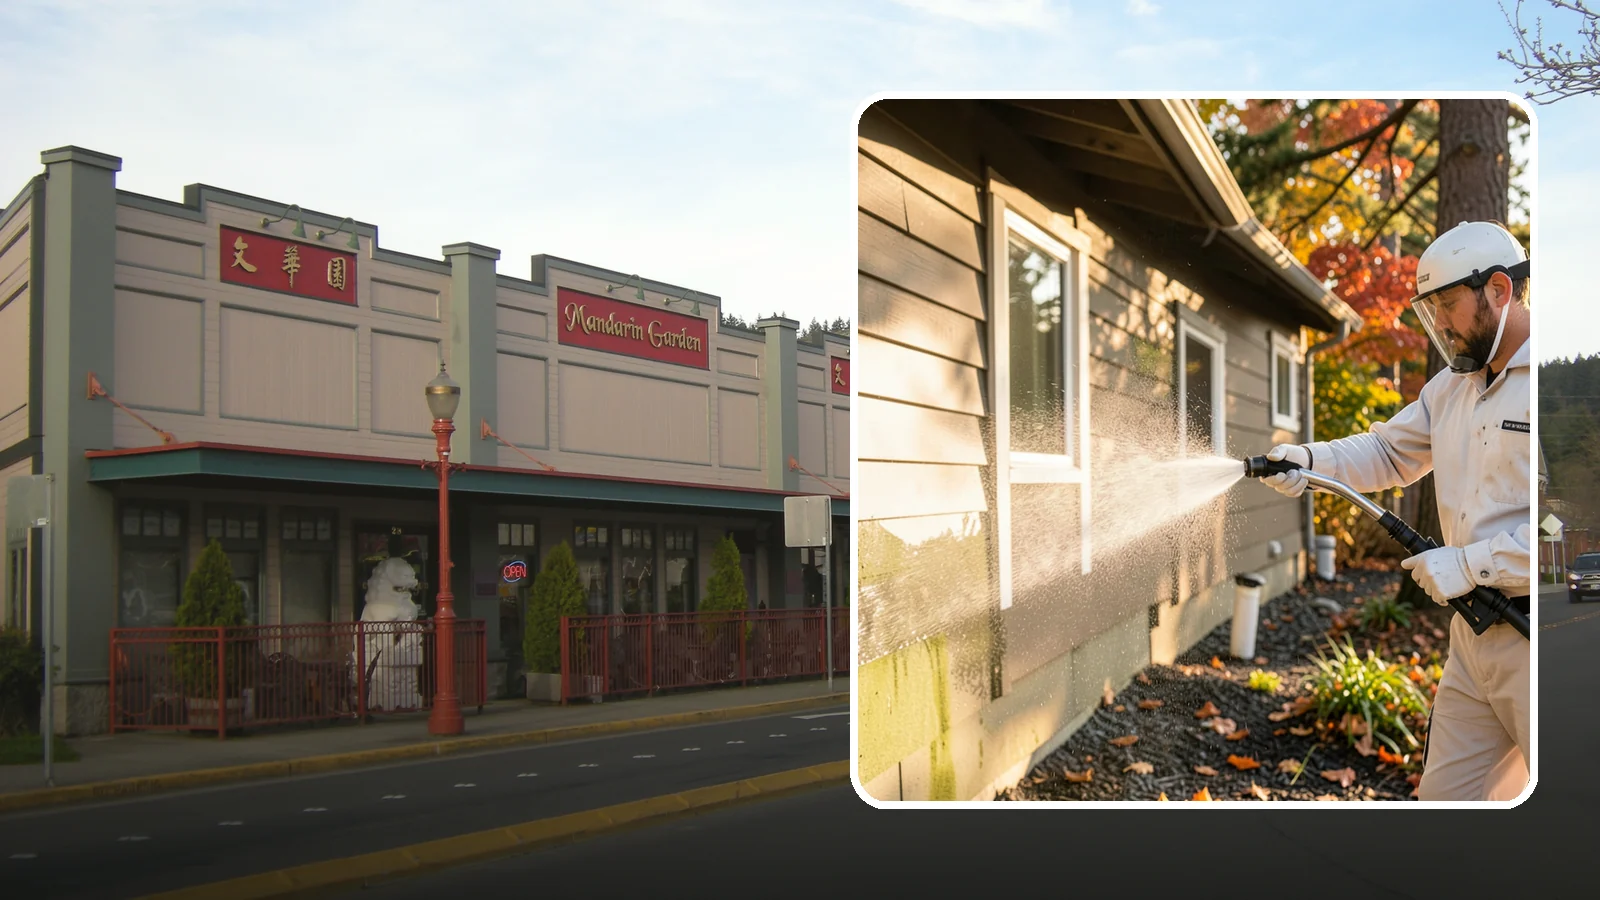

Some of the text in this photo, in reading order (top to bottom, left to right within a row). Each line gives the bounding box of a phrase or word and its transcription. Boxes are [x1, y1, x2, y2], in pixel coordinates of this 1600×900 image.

[231, 235, 346, 291] 文華園
[564, 302, 702, 352] Mandarin Garden
[834, 363, 846, 386] 文
[503, 565, 527, 578] OPEN
